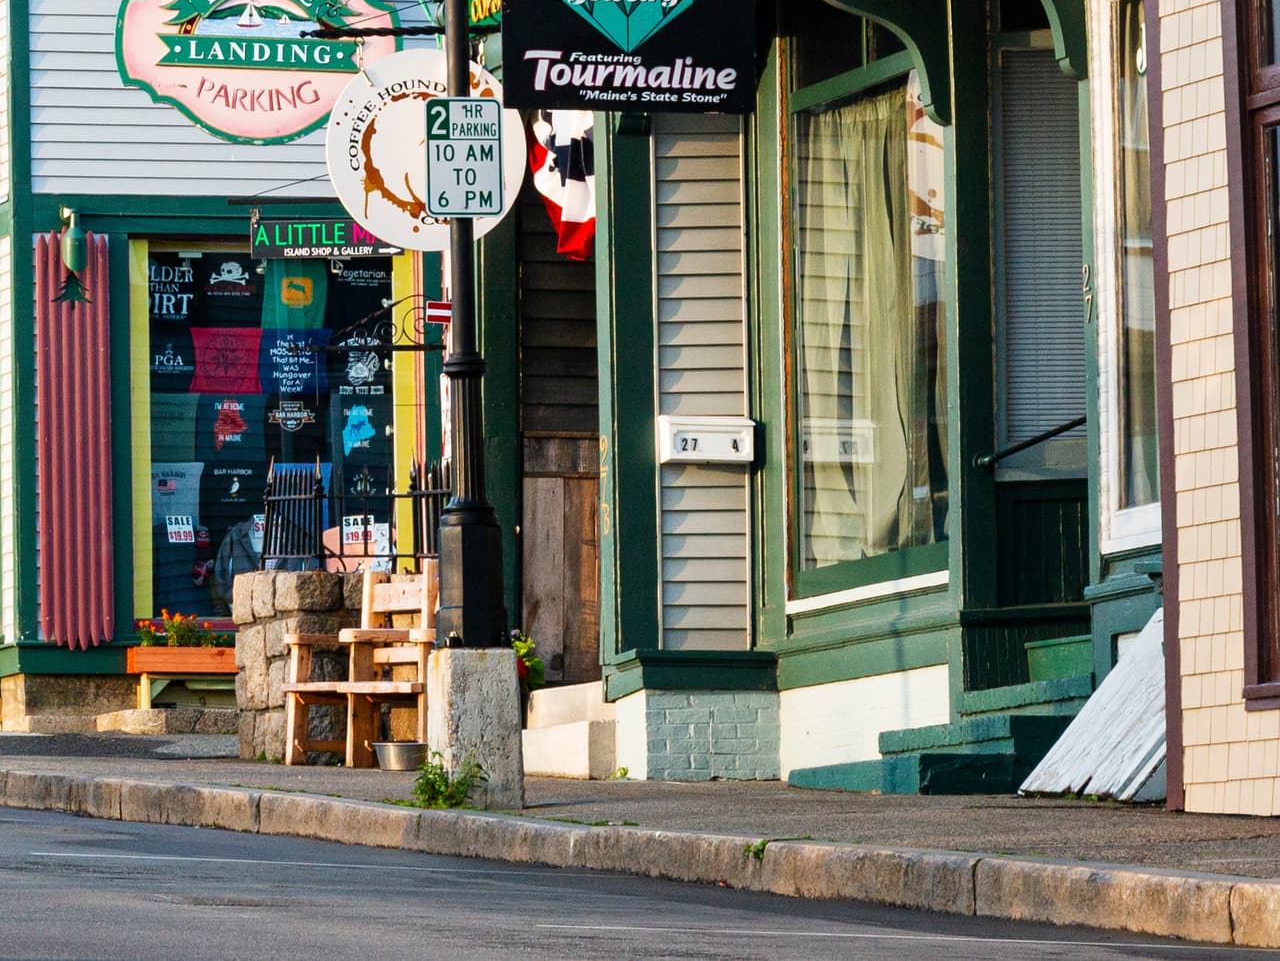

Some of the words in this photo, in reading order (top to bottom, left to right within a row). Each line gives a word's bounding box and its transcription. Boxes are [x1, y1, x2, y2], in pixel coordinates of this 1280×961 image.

[189, 40, 331, 64] LANDING
[569, 52, 641, 65] Featuring
[523, 50, 737, 91] Tourmaline
[196, 76, 321, 112] PARKING
[579, 90, 638, 102] "Maine's
[641, 91, 678, 102] State
[681, 92, 727, 103] Stone"
[430, 105, 447, 135] 2
[464, 104, 483, 118] HR
[349, 100, 377, 171] COFFEE
[452, 123, 497, 137] PARKING
[435, 144, 455, 161] 10
[466, 144, 493, 161] AM
[453, 168, 476, 186] TO
[438, 190, 449, 208] 6
[465, 190, 493, 208] PM
[255, 224, 270, 246] A
[275, 223, 346, 245] LITTLE
[284, 247, 310, 256] ISLAND
[311, 247, 332, 256] SHOP
[333, 247, 340, 255] &
[341, 246, 373, 255] GALLERY
[149, 265, 194, 282] LDER
[1082, 264, 1095, 324] 27
[152, 293, 194, 315] IRT
[154, 355, 184, 365] PGA
[273, 371, 312, 379] Hungover
[681, 437, 698, 452] 27
[213, 468, 226, 476] BAR
[227, 468, 253, 476] HARBOR
[167, 517, 191, 526] SALE
[169, 531, 193, 542] $19.99
